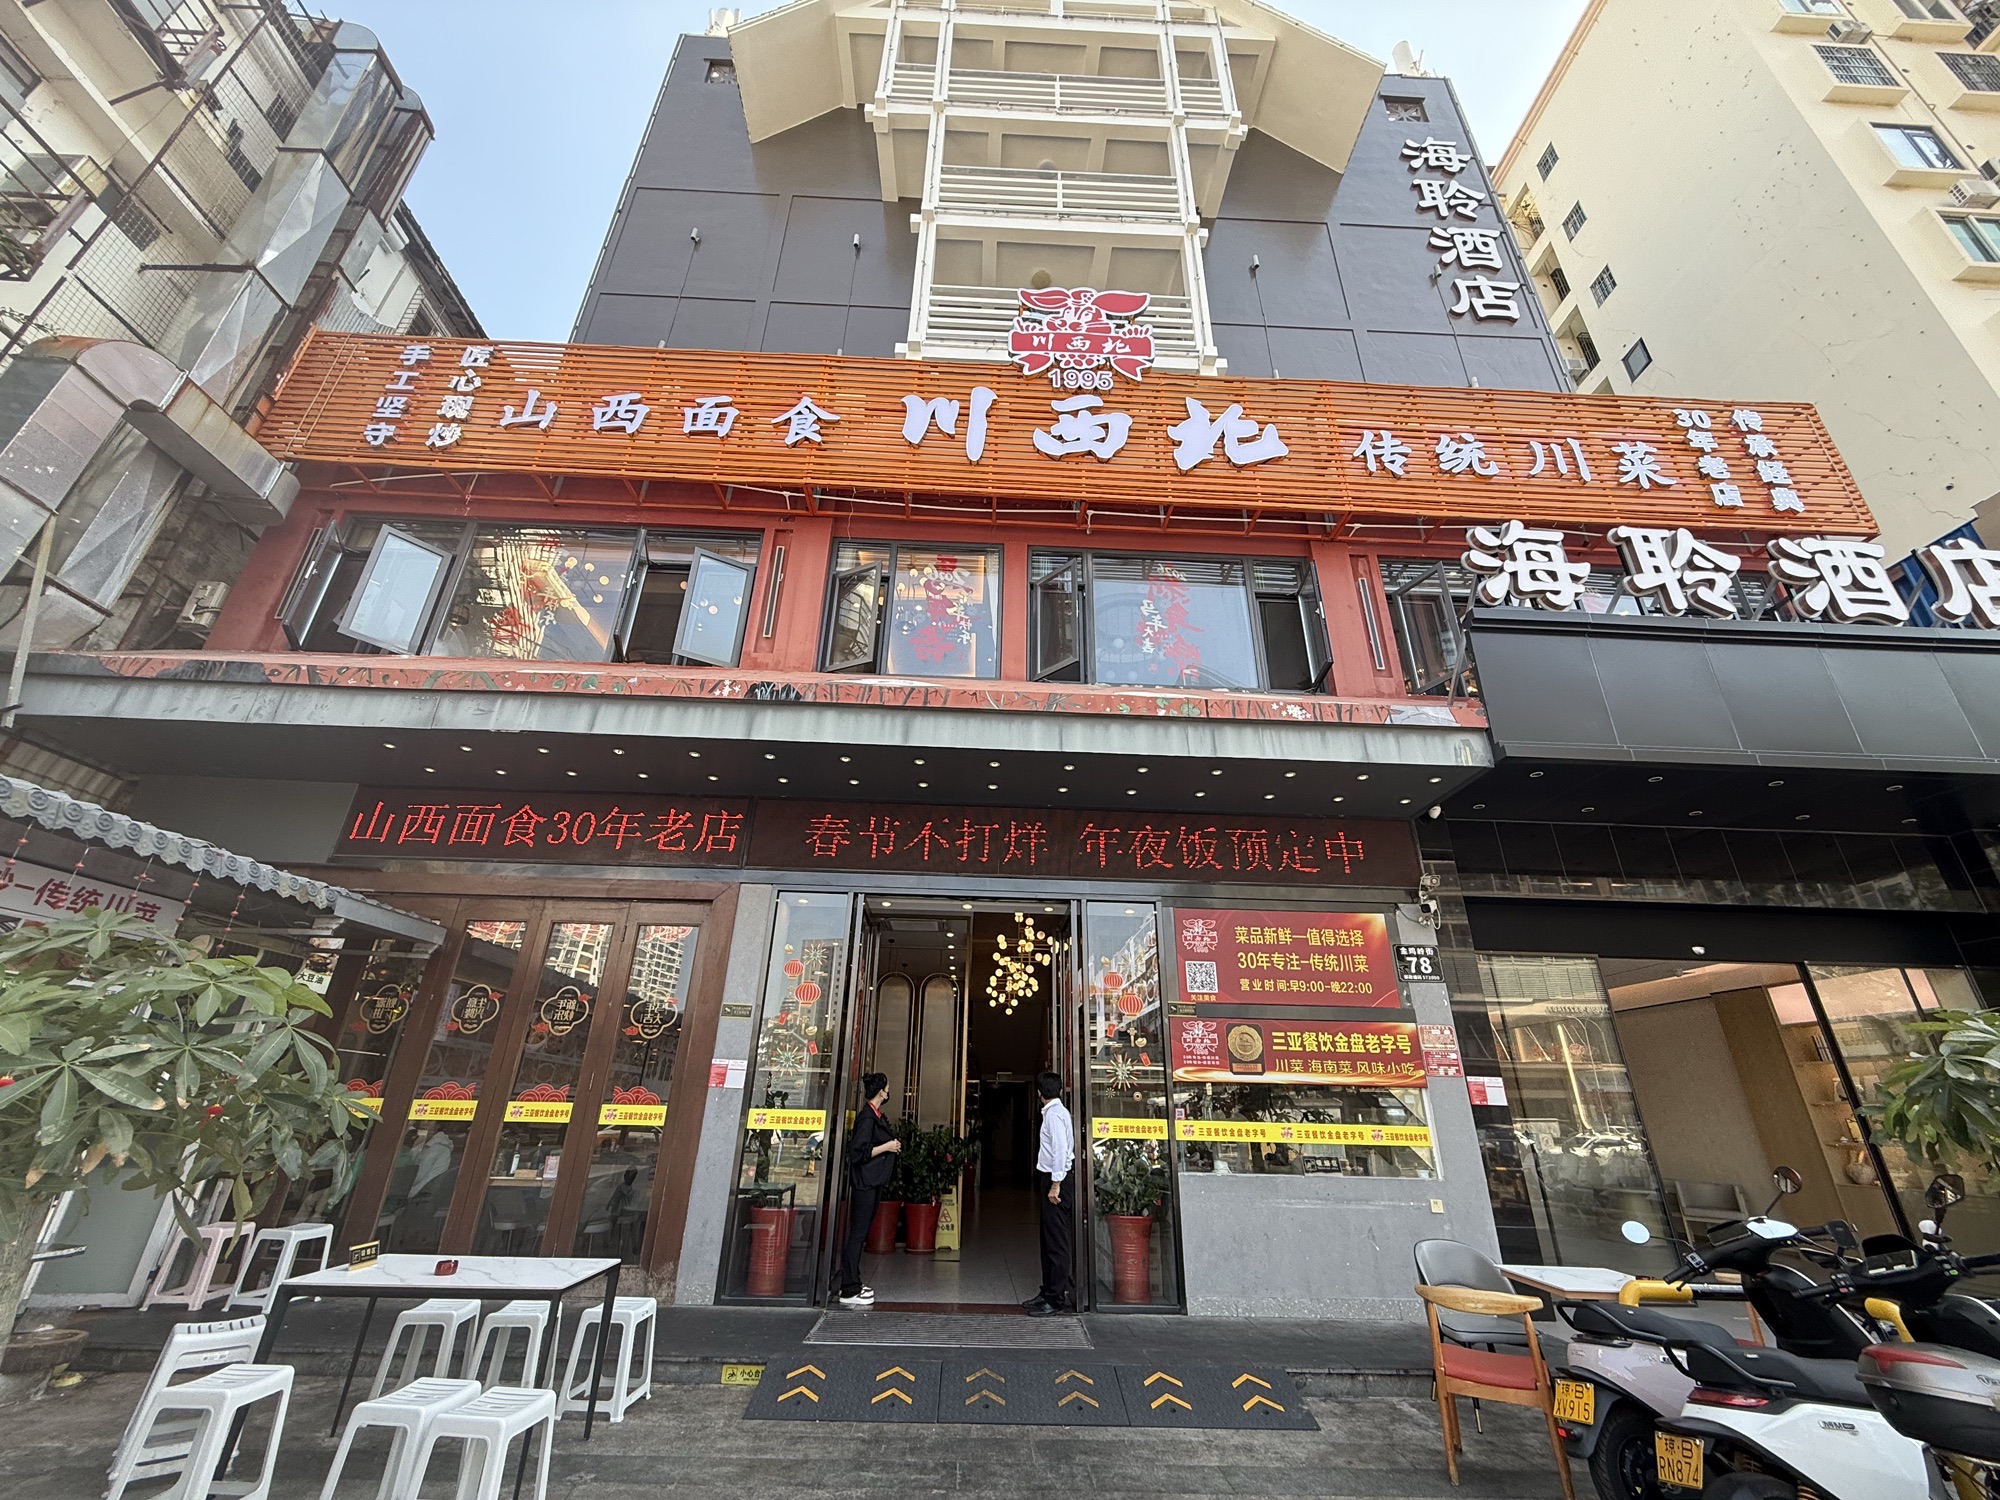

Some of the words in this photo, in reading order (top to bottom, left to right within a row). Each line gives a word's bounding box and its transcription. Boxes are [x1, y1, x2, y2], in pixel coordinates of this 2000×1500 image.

[1402, 137, 1521, 320] 海聆酒店
[1031, 334, 1132, 354] 川西北
[1047, 369, 1114, 390] 1995
[363, 344, 431, 446] 手工坚守
[425, 345, 494, 448] 匠心现炒
[500, 389, 841, 447] 山西面食
[901, 386, 1290, 472] 川西北
[1353, 429, 1677, 489] 传统川菜
[1672, 408, 1745, 508] 30年老店
[1731, 409, 1806, 513] 传承经典
[349, 802, 745, 853] 山西面食30年老店
[805, 814, 1049, 866] 春节不打烊
[1079, 822, 1365, 875] 年夜饭预定中
[1406, 957, 1433, 973] 78
[1271, 1032, 1412, 1055] 三亚餐饮金盘老字号
[1275, 1059, 1304, 1072] 川菜
[1307, 1060, 1353, 1074] 海南菜
[1357, 1061, 1416, 1076] 风味小吃
[428, 1107, 474, 1116] 三亚餐饮金盘老字号
[523, 1108, 570, 1118] 三亚餐饮金盘老字号
[617, 1111, 663, 1121] 三亚餐饮金盘老字号
[769, 1115, 822, 1125] 三亚餐饮金盘老字号
[1112, 1124, 1164, 1135] 三亚餐饮金盘老字号
[1198, 1127, 1267, 1138] 三亚餐饮金盘老字号
[1296, 1130, 1365, 1141] 三亚餐饮金盘老字号
[1385, 1132, 1428, 1142] 三亚餐饮金盘老字号
[1555, 1399, 1590, 1421] XV915
[1659, 1456, 1700, 1484] RN874
